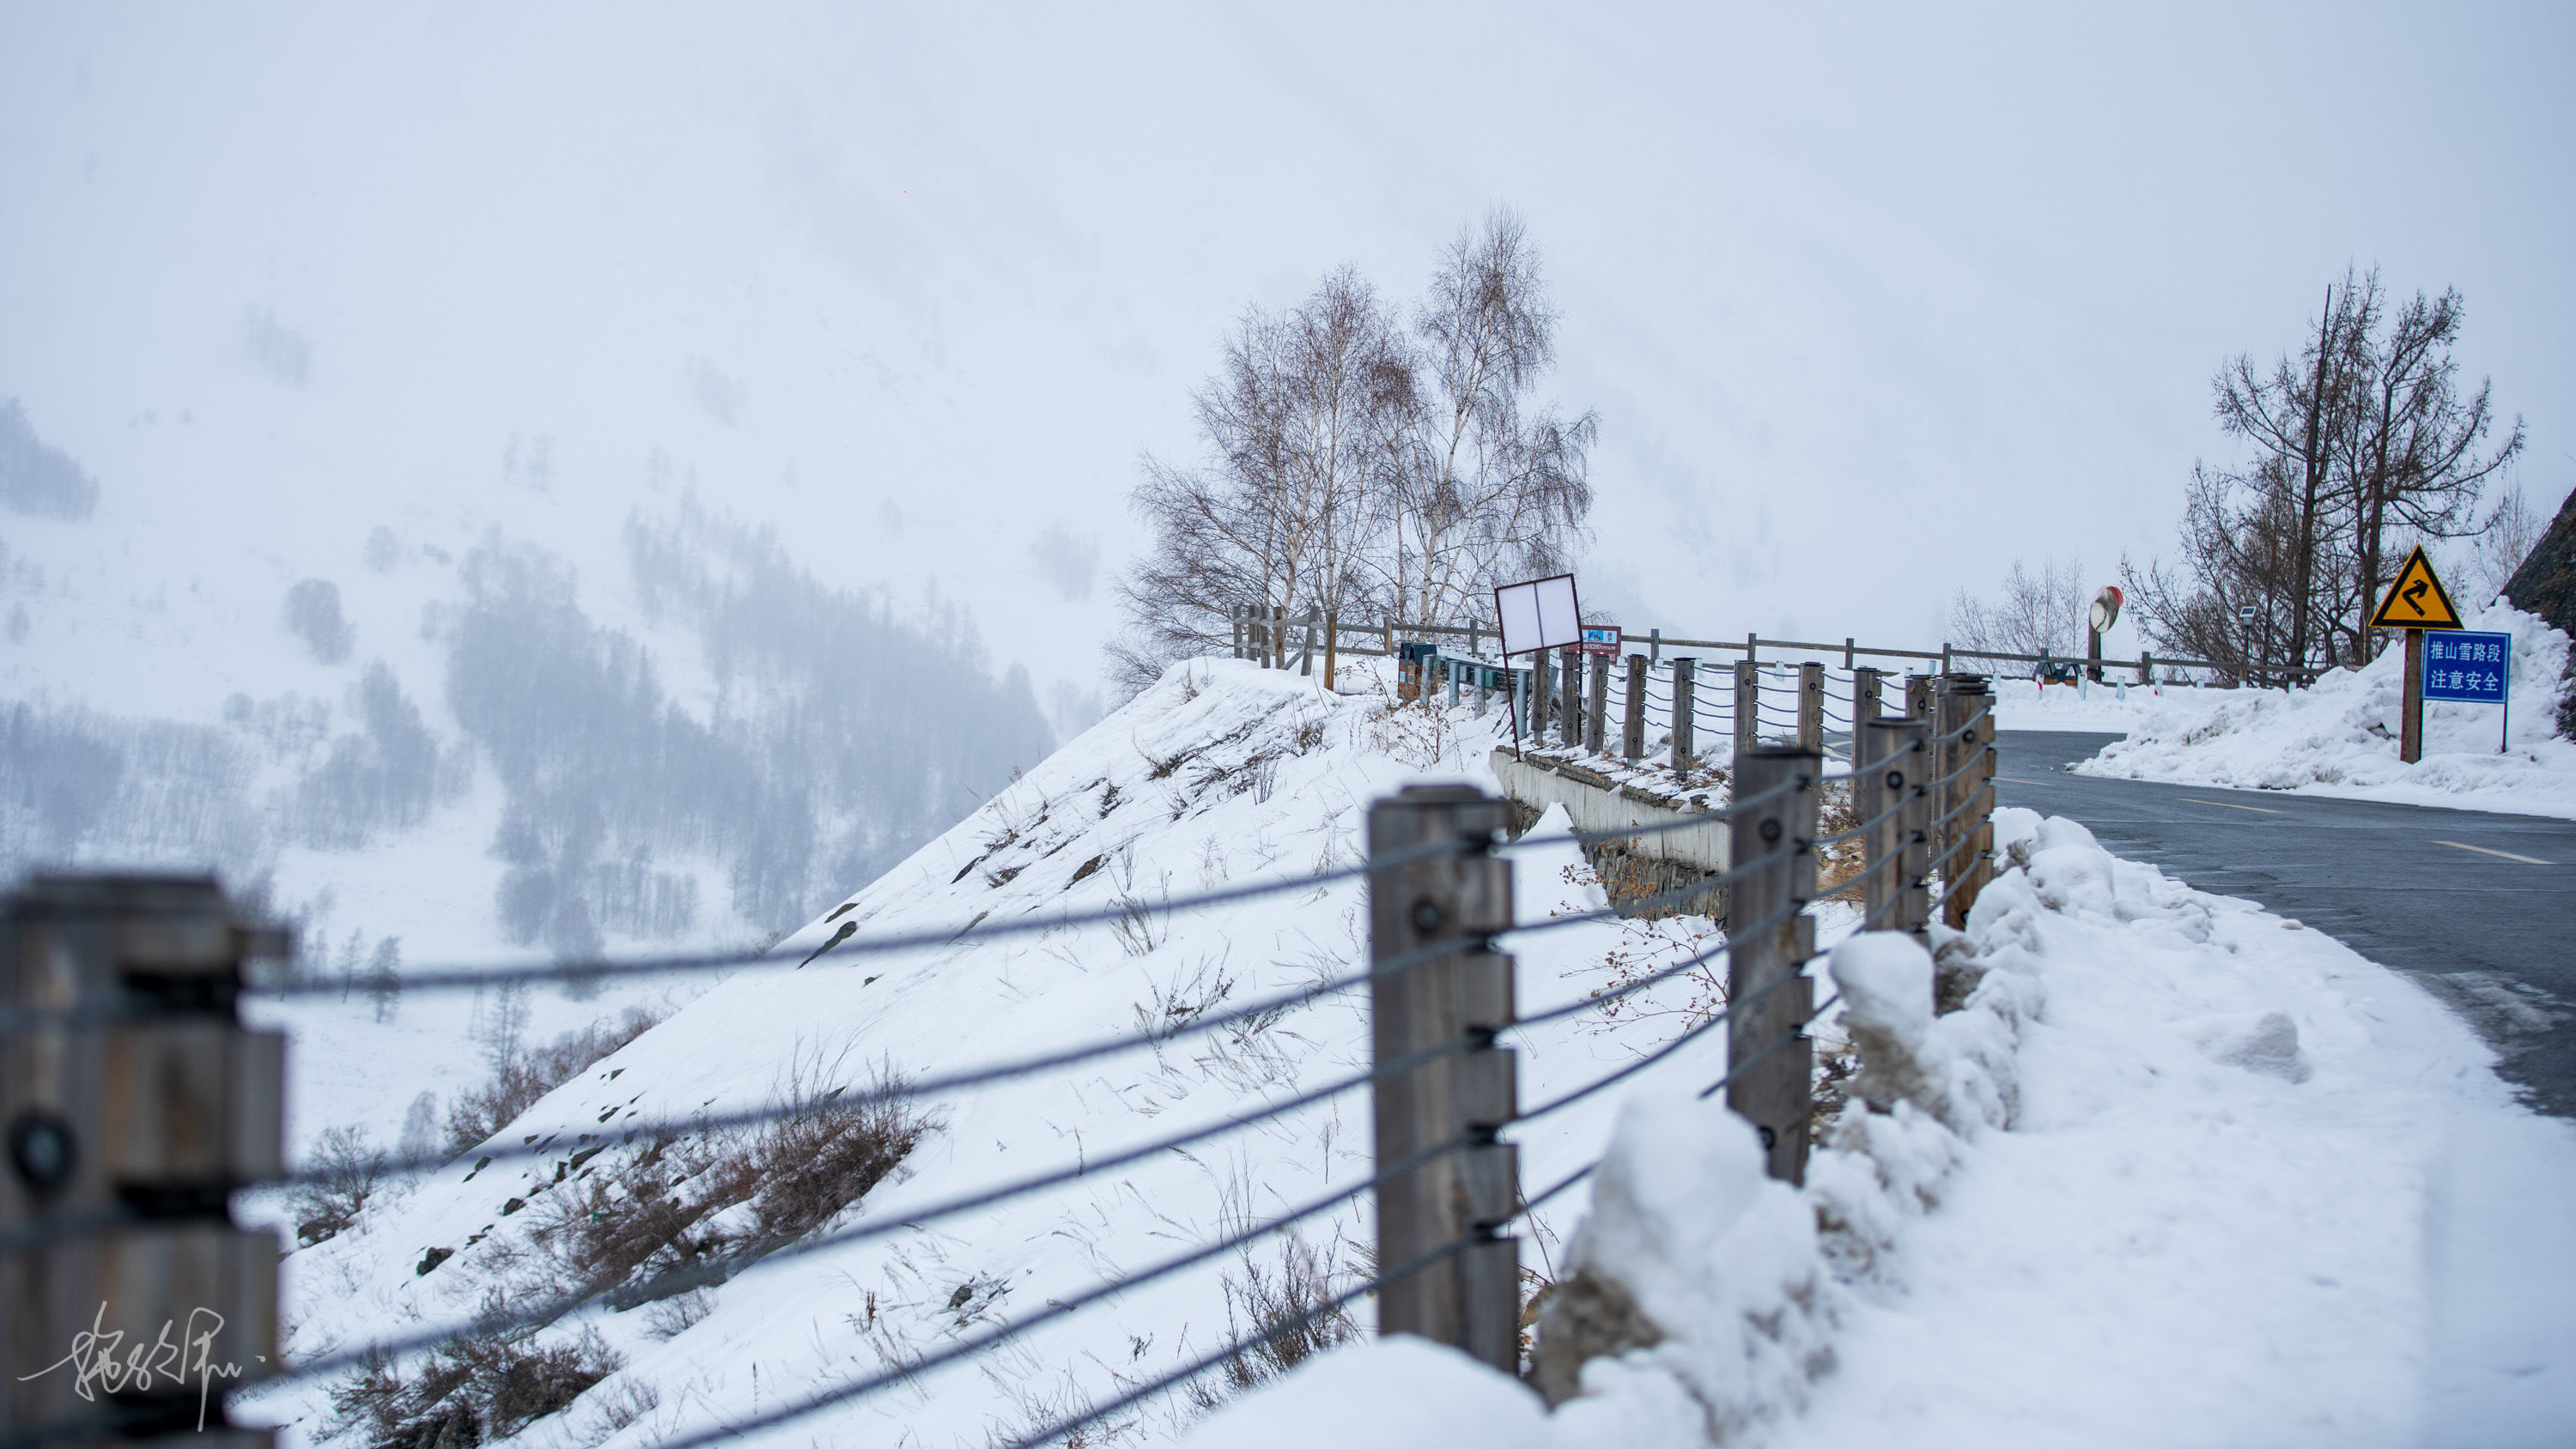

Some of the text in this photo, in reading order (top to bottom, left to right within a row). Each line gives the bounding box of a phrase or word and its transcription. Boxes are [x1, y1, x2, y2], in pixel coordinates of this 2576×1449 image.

[2431, 640, 2500, 663] 推山雪路段
[2431, 670, 2499, 692] 注意安全
